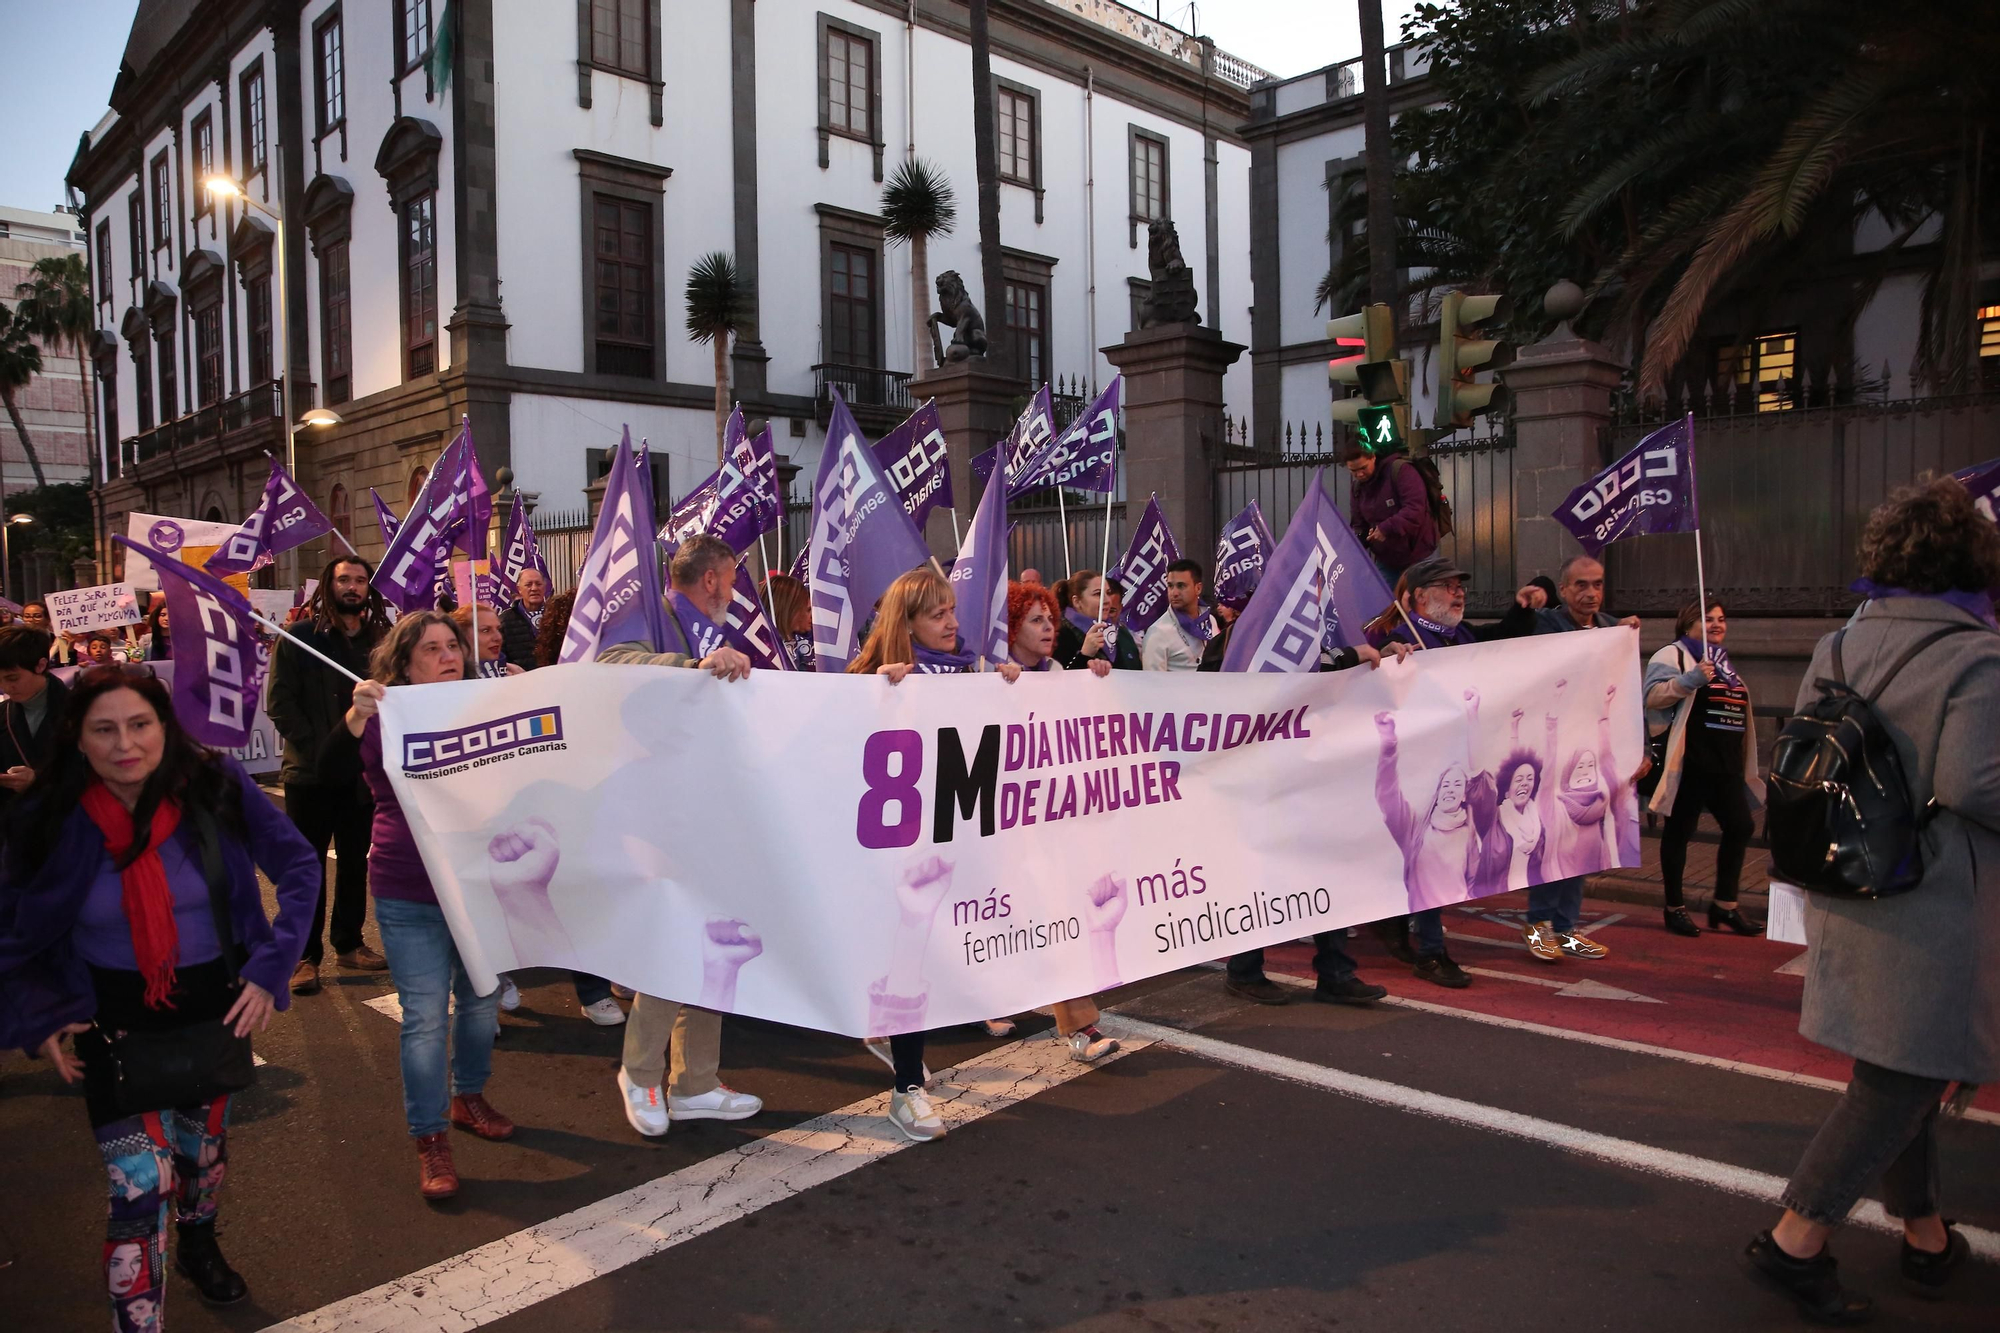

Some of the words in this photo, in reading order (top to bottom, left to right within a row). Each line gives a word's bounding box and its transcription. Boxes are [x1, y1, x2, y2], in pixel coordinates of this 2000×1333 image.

[60, 615, 89, 630] FALTE
[404, 764, 470, 780] comisiones
[473, 751, 515, 768] obreras
[518, 741, 567, 757] Canarias
[407, 722, 515, 767] CCOO
[1004, 712, 1053, 772] DÍA
[1055, 704, 1311, 765] INTERNACIONAL
[1000, 779, 1041, 831] DE
[1044, 774, 1077, 823] LA
[1083, 760, 1183, 816] MUJER
[1135, 858, 1207, 906] más
[953, 888, 1011, 927] más
[1154, 887, 1331, 953] sindicalismo
[963, 915, 1081, 966] feminismo
